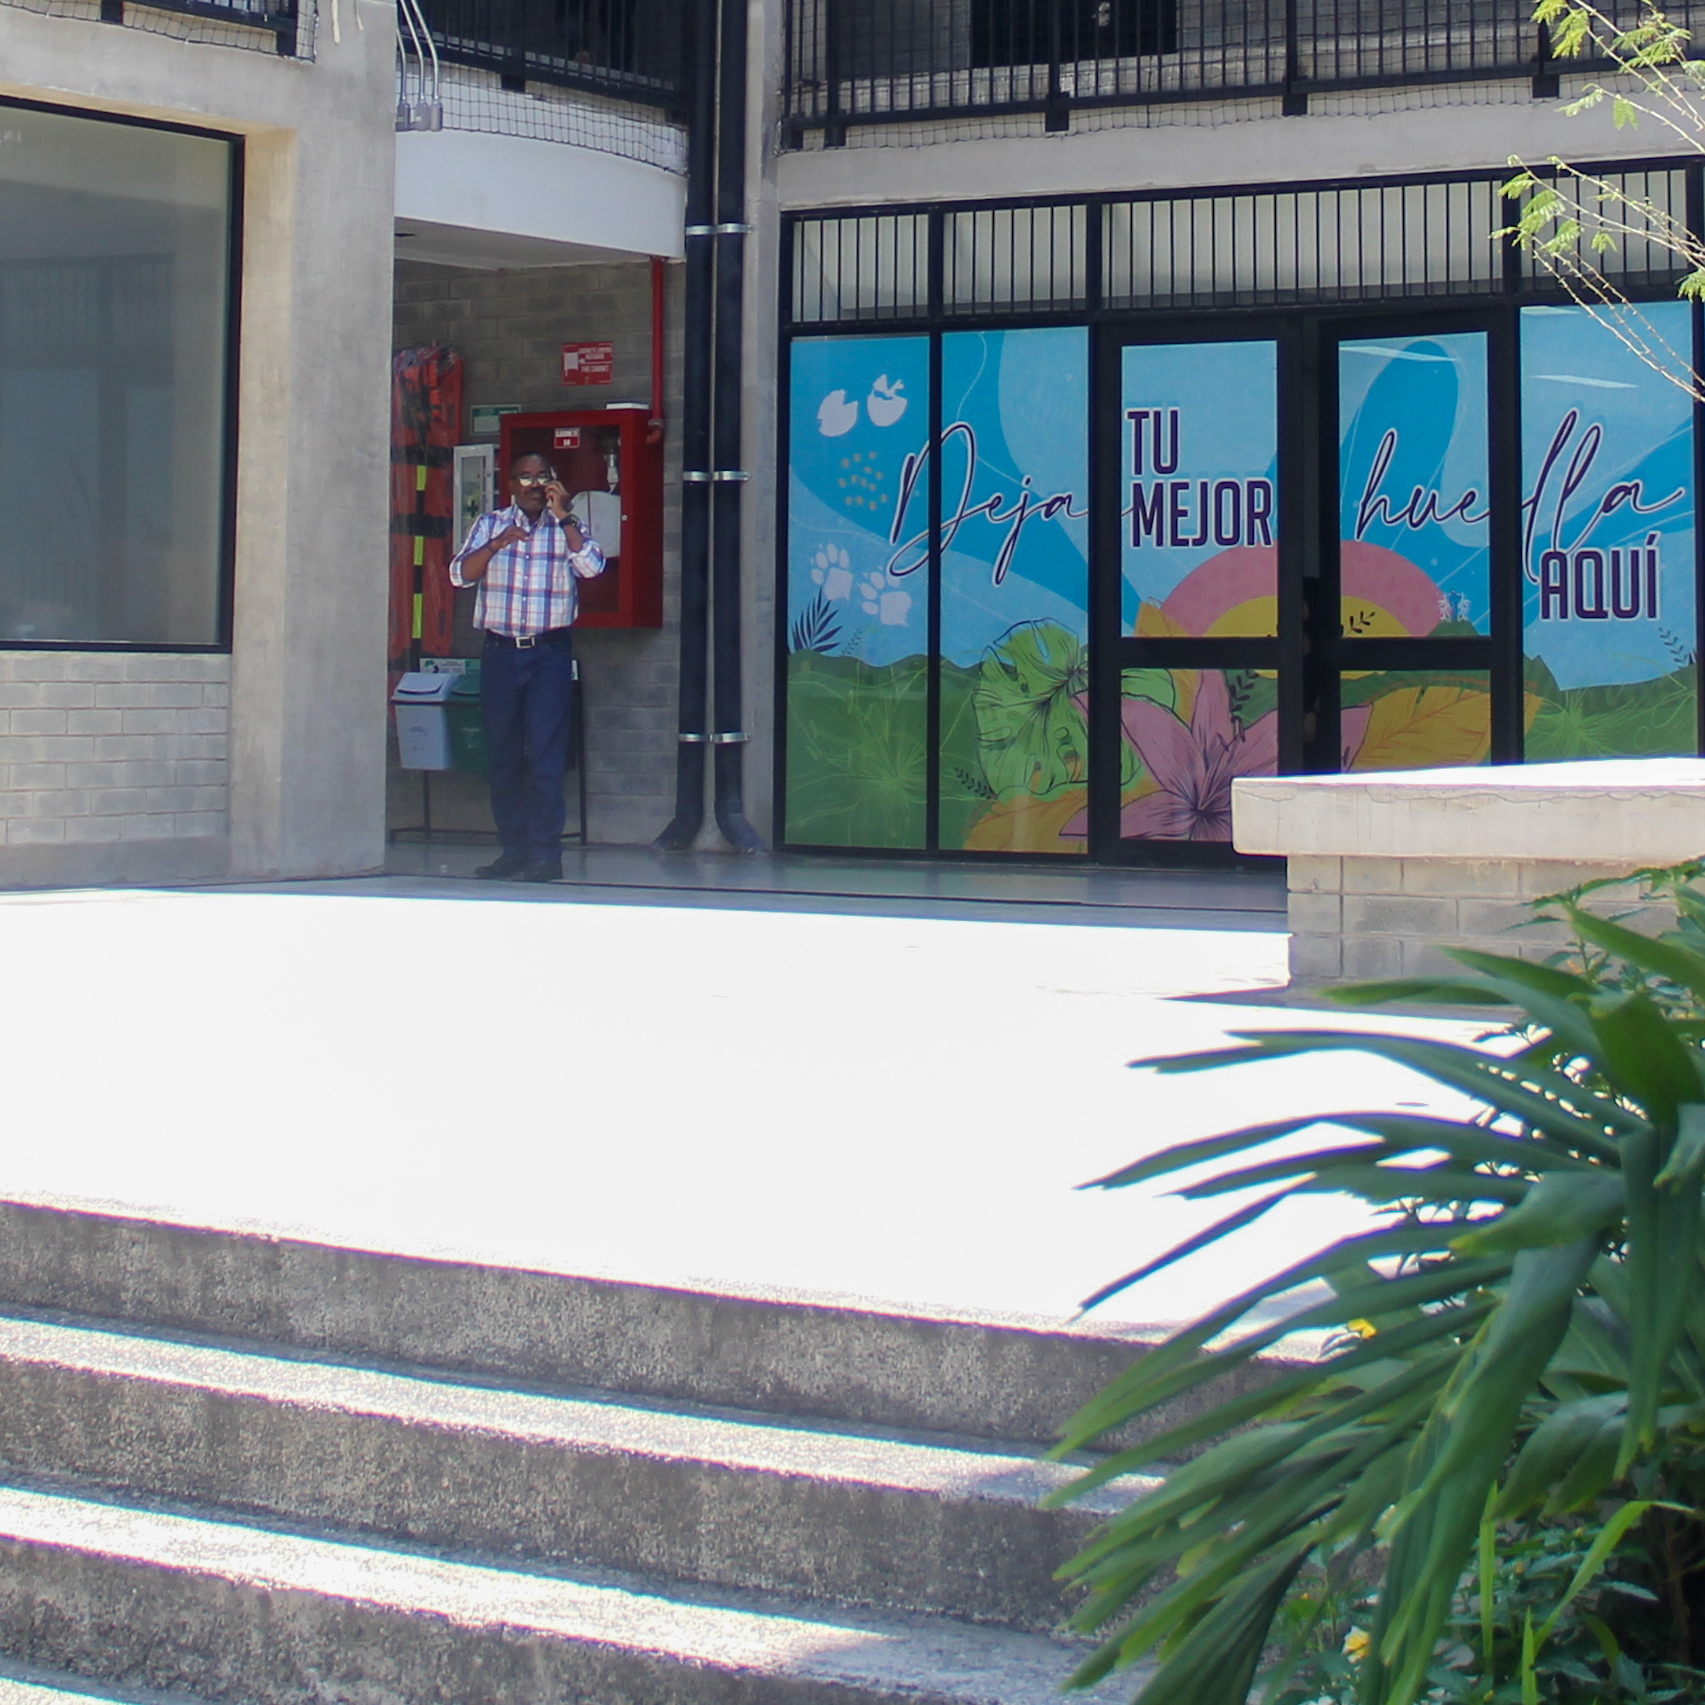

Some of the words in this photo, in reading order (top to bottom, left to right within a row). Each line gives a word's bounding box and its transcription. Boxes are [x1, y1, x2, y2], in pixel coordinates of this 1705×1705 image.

[1127, 408, 1180, 475] TU
[889, 422, 1090, 586] Deja
[1131, 479, 1274, 547] MEJOR
[1354, 408, 1686, 585] huella
[1540, 532, 1658, 619] AQUÍ
